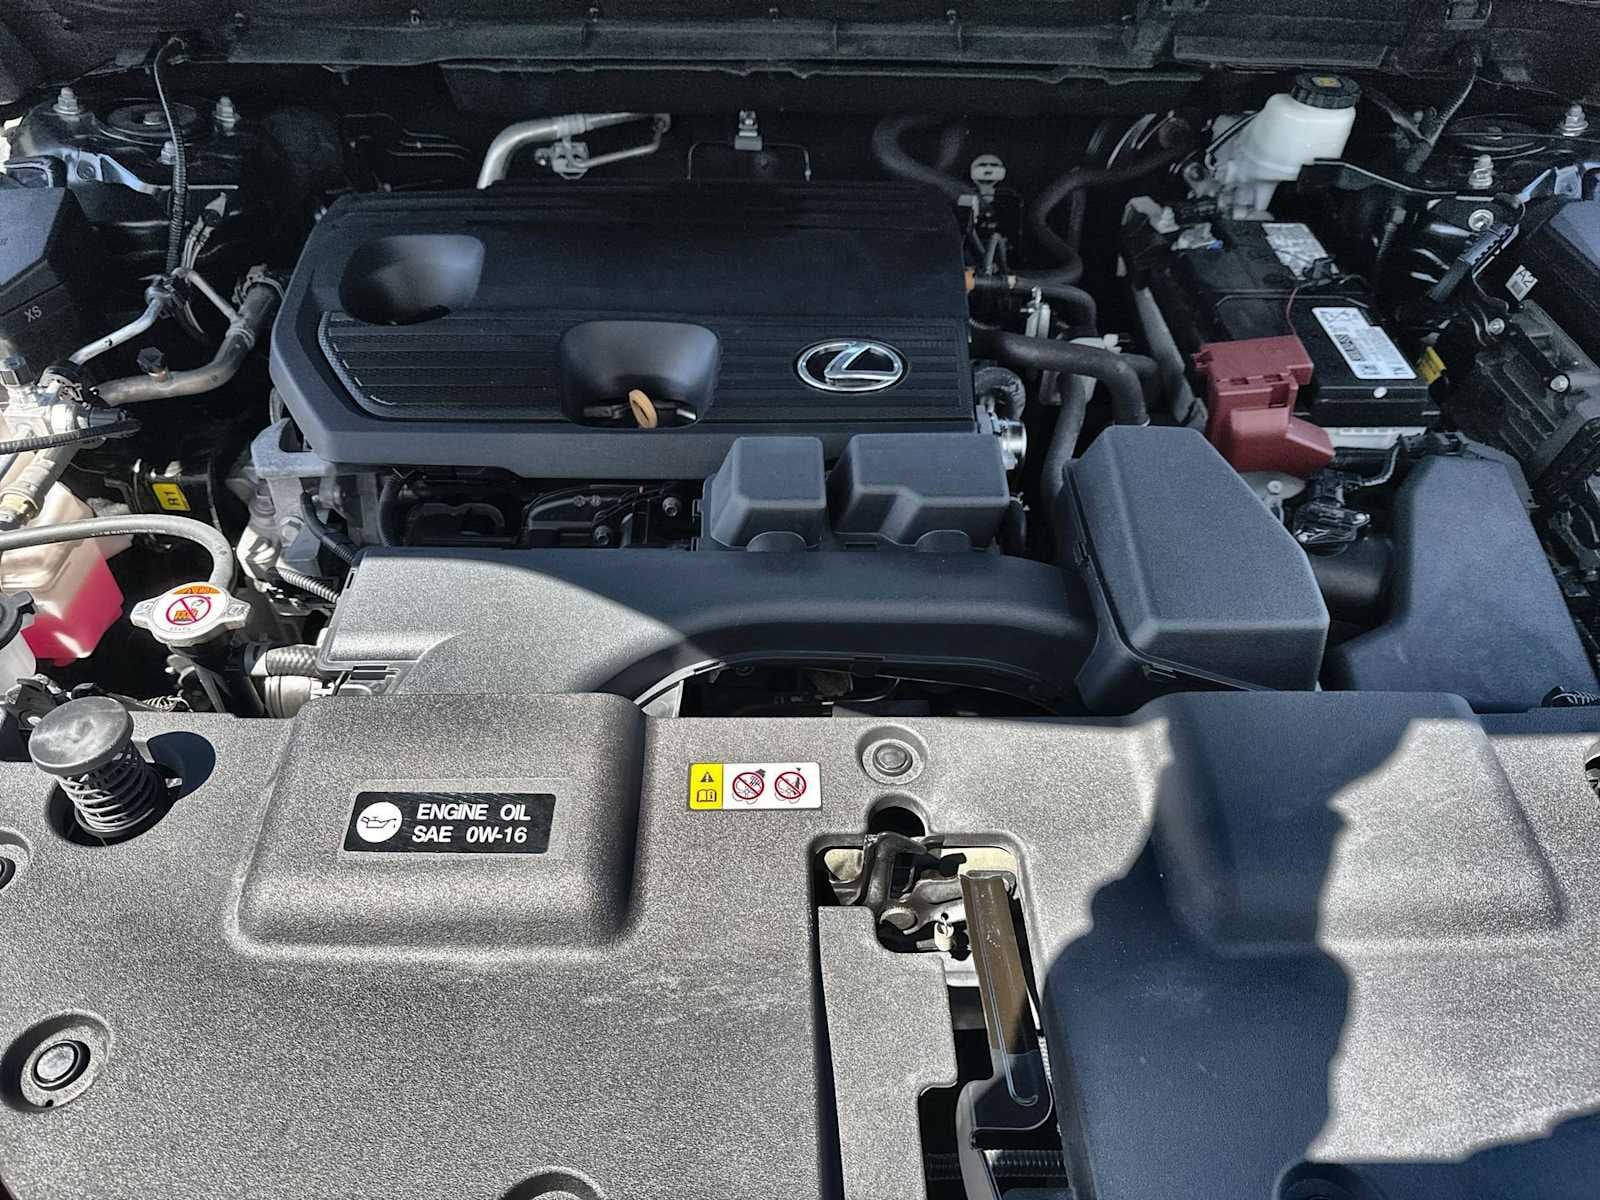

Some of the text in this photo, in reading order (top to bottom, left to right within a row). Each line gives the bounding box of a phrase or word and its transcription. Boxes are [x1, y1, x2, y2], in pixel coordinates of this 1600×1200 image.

[416, 803, 531, 821] ENGINE OIL
[412, 825, 528, 843] SAE 0W-16
